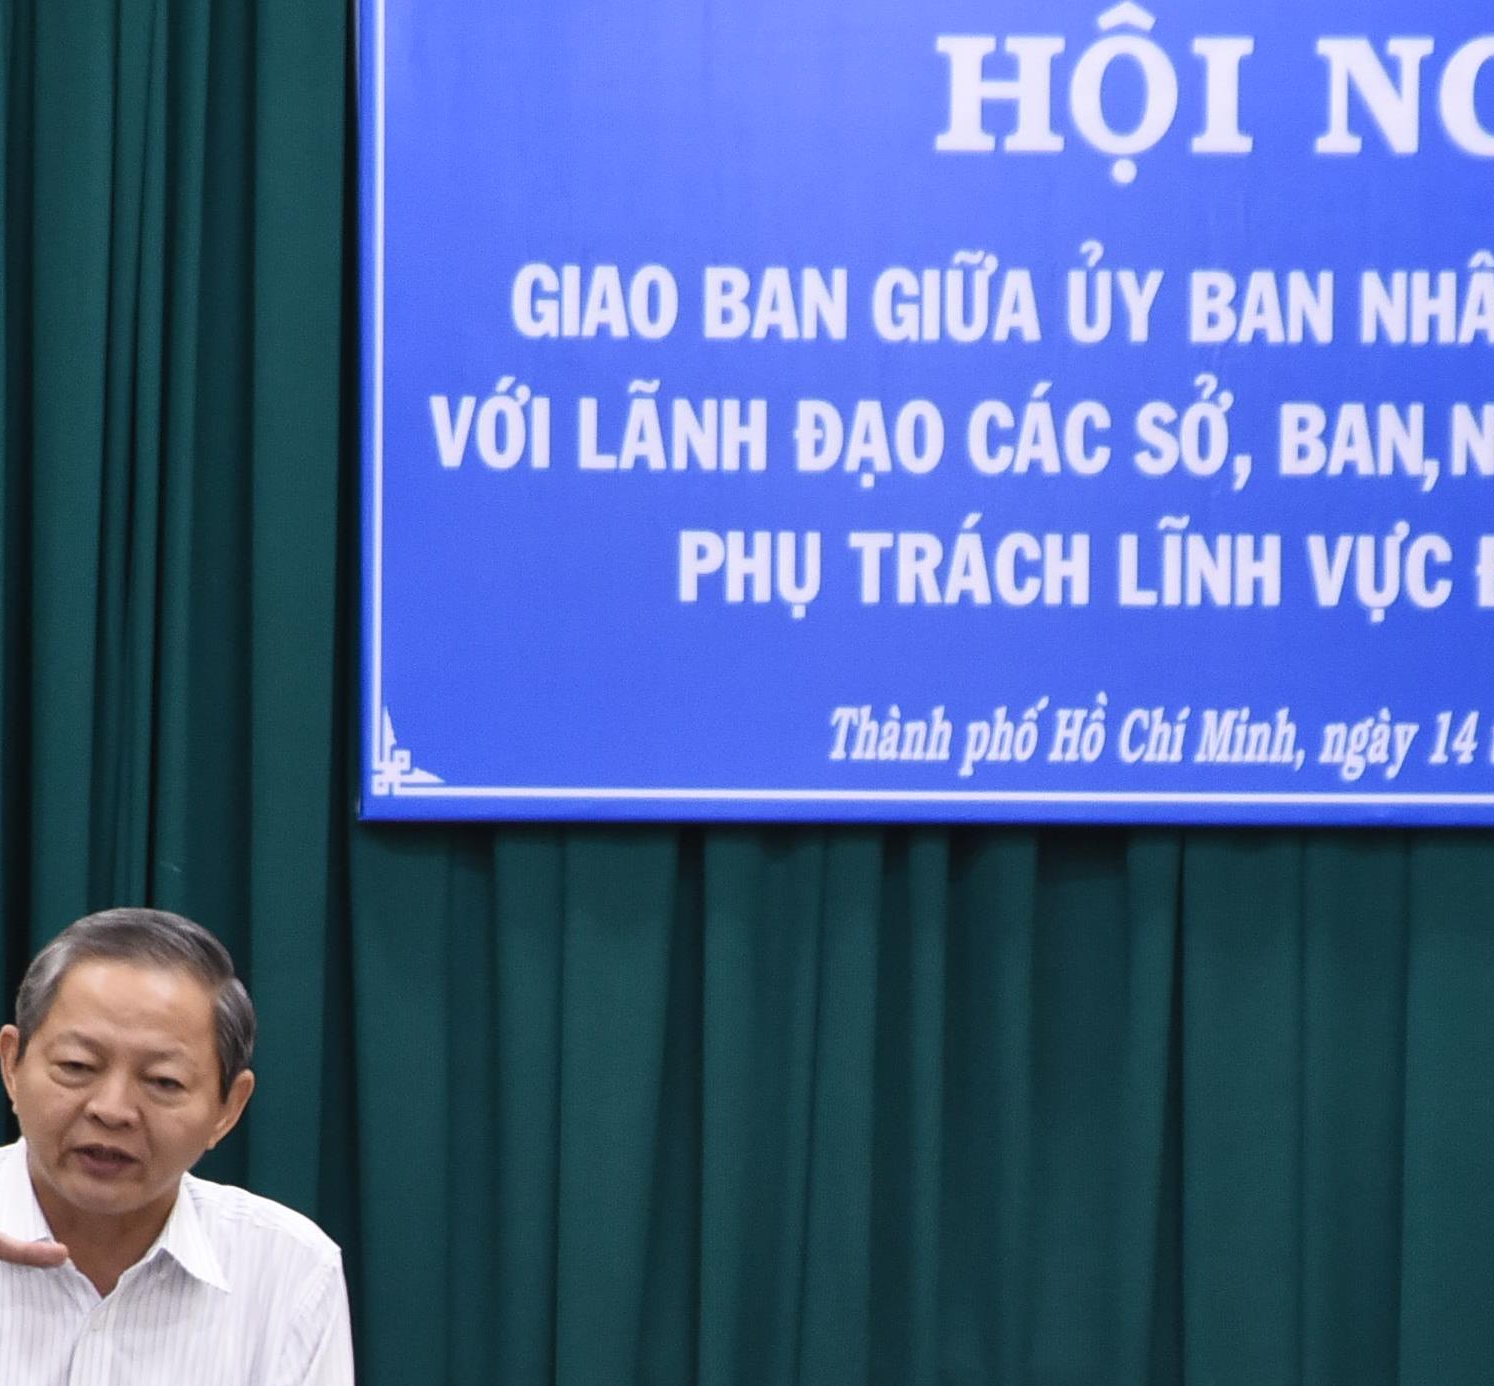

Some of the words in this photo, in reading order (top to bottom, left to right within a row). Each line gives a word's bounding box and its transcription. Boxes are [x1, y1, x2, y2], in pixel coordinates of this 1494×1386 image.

[935, 0, 1255, 187] HỘI
[511, 261, 679, 340] GIAO
[703, 264, 848, 342] BAN
[870, 248, 1041, 345] GIỮA
[1065, 239, 1164, 345] ỦY
[1188, 268, 1333, 345] BAN
[429, 375, 550, 470] VỚI
[578, 378, 767, 473] LÃNH
[793, 398, 945, 489] ĐẠO
[966, 380, 1111, 476] CÁC
[1134, 373, 1253, 492] SỞ,
[678, 530, 822, 621] PHỤ
[848, 512, 1090, 607] TRÁCH
[1118, 514, 1281, 607] LĨNH
[1307, 518, 1453, 624] VỰC
[828, 704, 953, 762] Thành
[957, 696, 1049, 777] phố
[1048, 690, 1109, 763] Hồ
[1119, 705, 1191, 764] Chí
[1193, 706, 1306, 772] Minh,
[1318, 707, 1419, 782] ngày
[1429, 710, 1480, 765] 14
